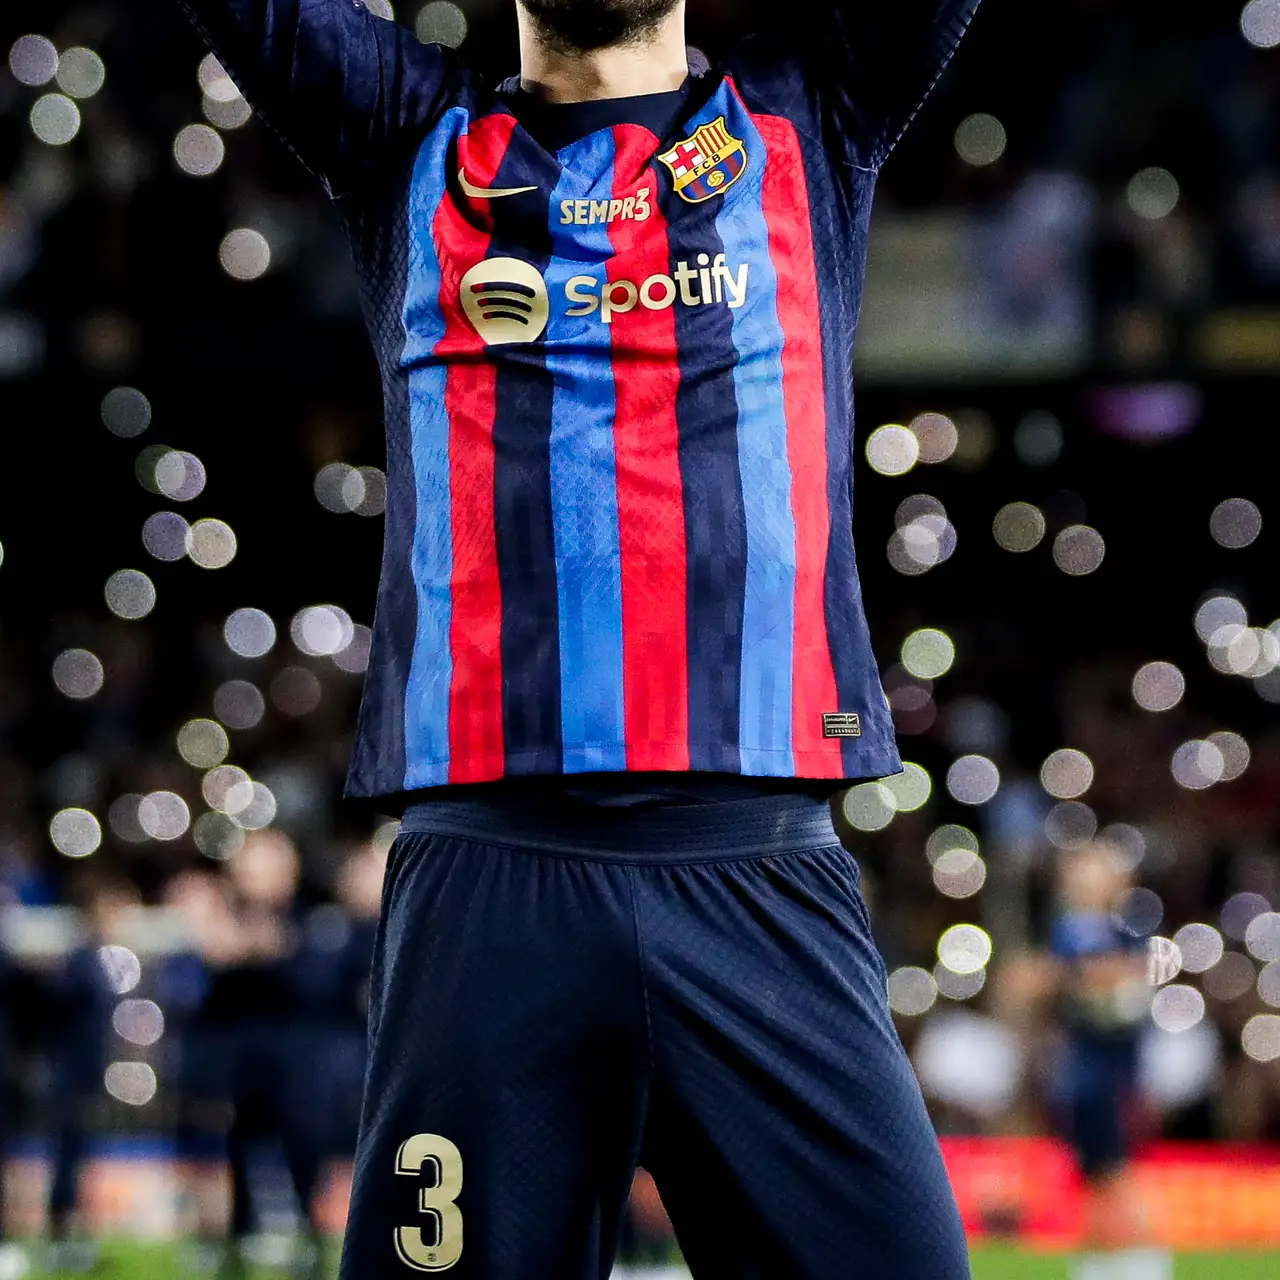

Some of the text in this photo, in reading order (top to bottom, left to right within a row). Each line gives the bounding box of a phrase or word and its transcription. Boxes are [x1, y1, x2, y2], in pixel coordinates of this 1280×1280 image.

[693, 154, 720, 176] FCB
[560, 188, 650, 225] SEMPR3
[565, 254, 748, 323] Spotify
[394, 1133, 463, 1272] 3
